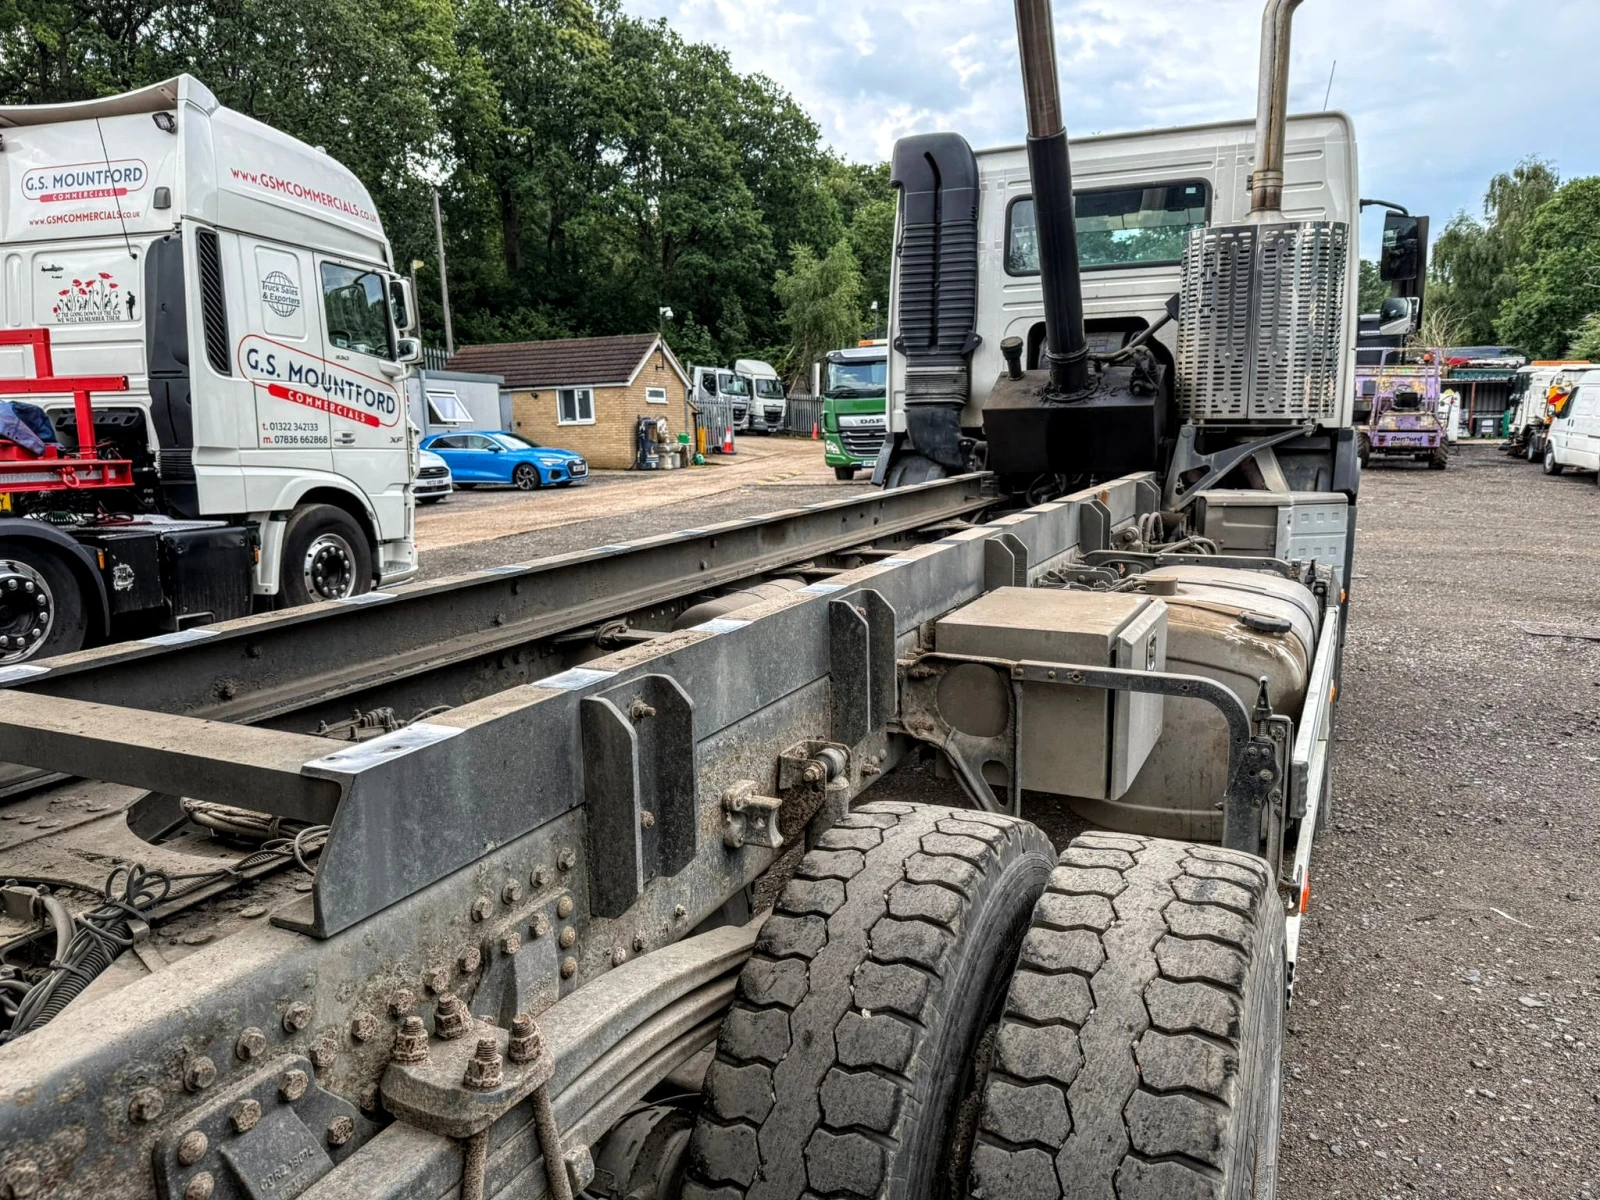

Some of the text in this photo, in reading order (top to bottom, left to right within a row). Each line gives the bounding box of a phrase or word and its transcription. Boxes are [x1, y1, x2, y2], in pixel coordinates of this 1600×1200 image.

[26, 167, 143, 191] G.S. MOUNTFORD
[52, 189, 114, 201] COMMERCIALS
[261, 280, 299, 296] Truck Sales
[262, 291, 301, 305] & Exporters
[247, 348, 395, 415] G.S. MOUNTFORD
[287, 390, 366, 422] COMMERCIALS
[269, 422, 292, 431] 01322
[293, 422, 319, 431] 342133
[274, 435, 299, 444] 07836
[299, 435, 328, 444] 662868
[389, 436, 404, 444] XF
